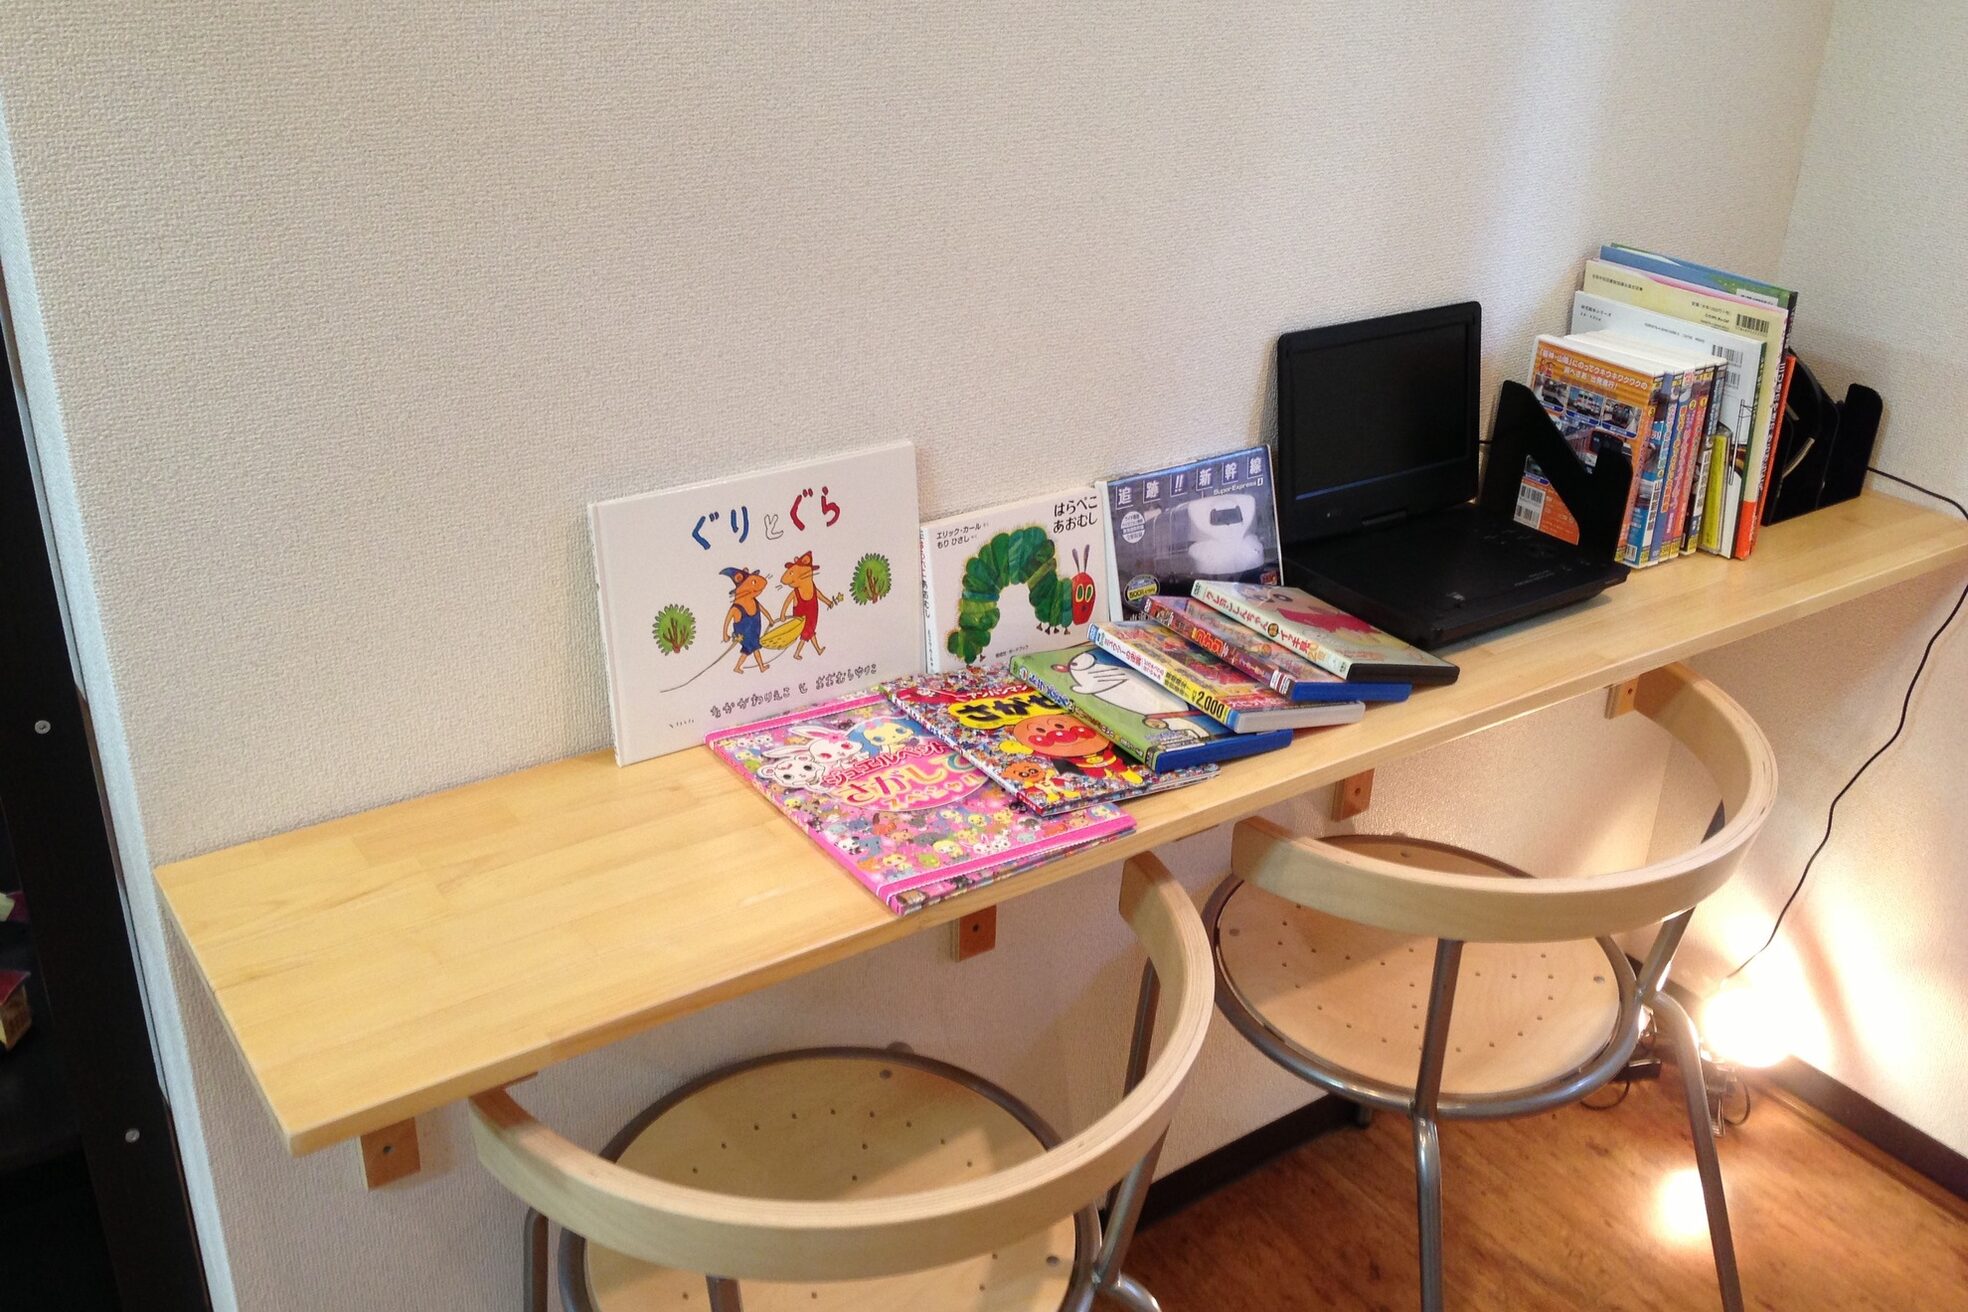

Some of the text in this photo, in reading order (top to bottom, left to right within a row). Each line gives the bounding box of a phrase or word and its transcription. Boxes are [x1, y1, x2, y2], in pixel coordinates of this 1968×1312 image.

[692, 486, 840, 550] ぐりとぐら
[1054, 496, 1098, 517] はらぺこ
[937, 523, 981, 540] エリック・カール
[1053, 512, 1098, 534] あおむし
[1205, 590, 1268, 631] クレヨンしんちゃん
[1195, 691, 1225, 719] 2,000
